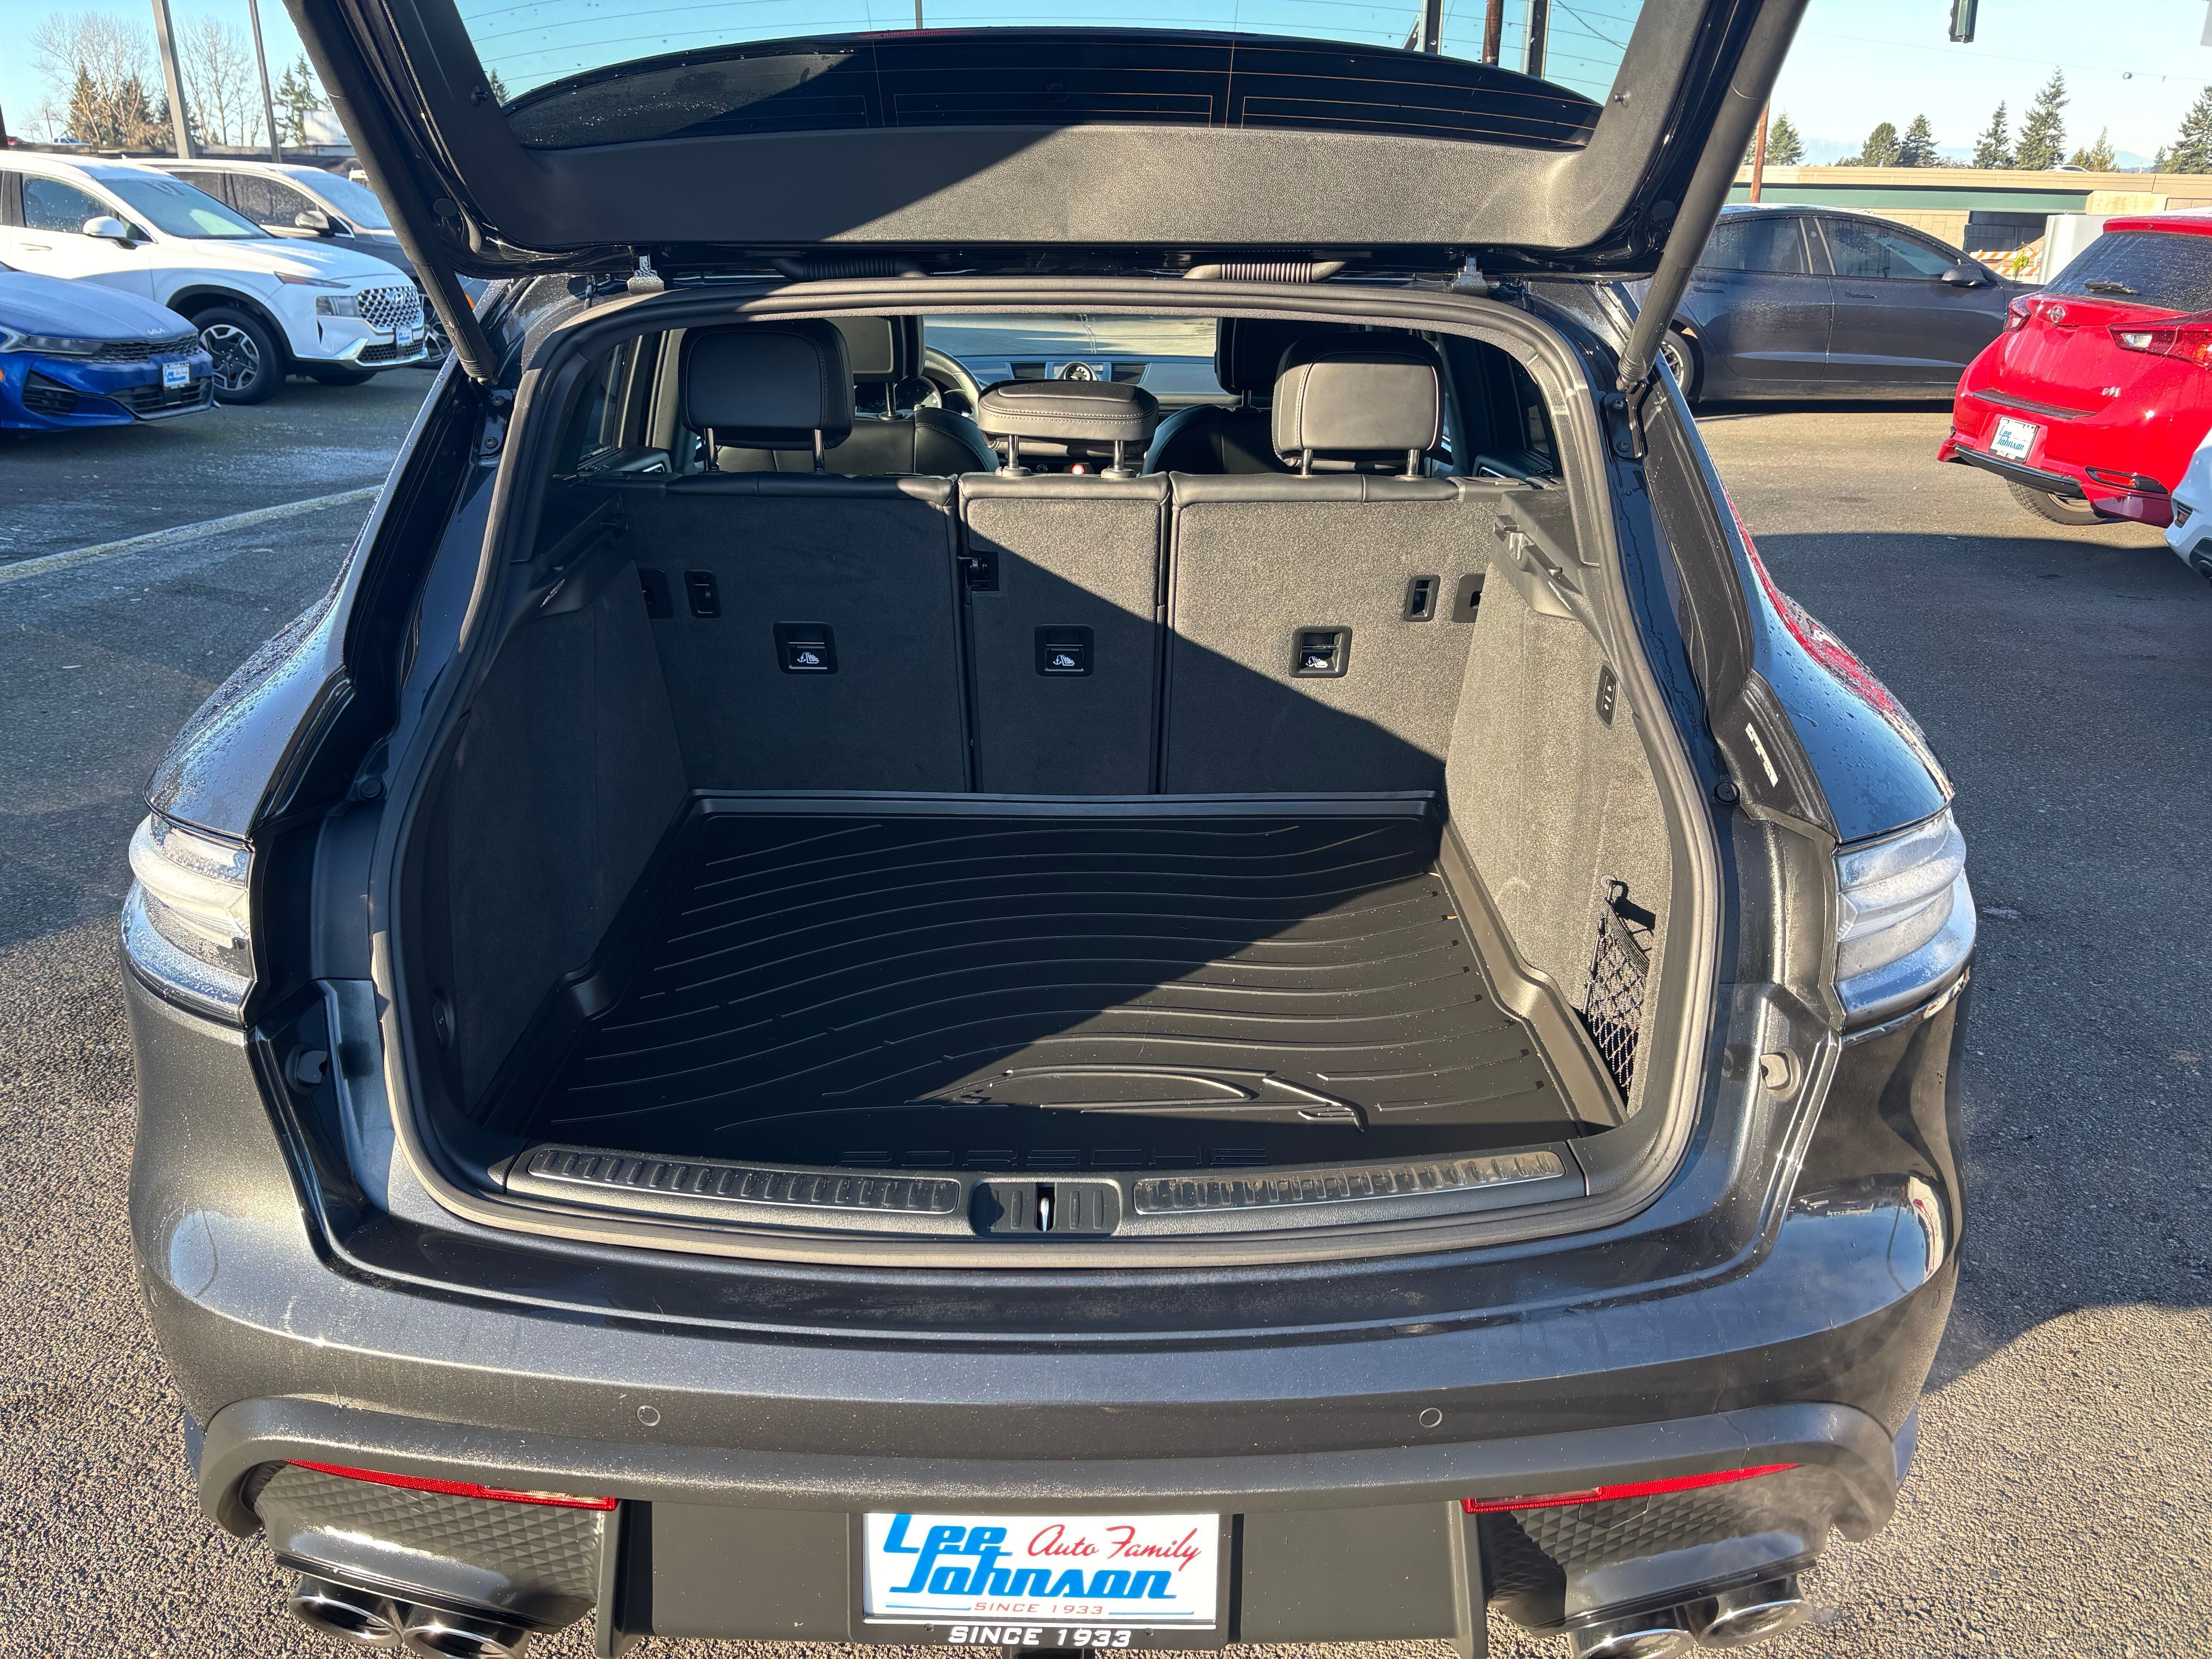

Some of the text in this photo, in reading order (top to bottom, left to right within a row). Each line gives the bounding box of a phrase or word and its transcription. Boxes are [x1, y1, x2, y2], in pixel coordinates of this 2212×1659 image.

[1999, 425, 2012, 437] Lee
[1996, 434, 2025, 451] Johnson
[835, 1147, 1268, 1167] PORSCHE
[883, 1514, 1009, 1557] Lee
[1027, 1524, 1202, 1572] Auto Family
[889, 1550, 1177, 1599] Johnson
[974, 1602, 1103, 1614] SINCE 1933
[948, 1626, 1132, 1647] SINCE 1933
